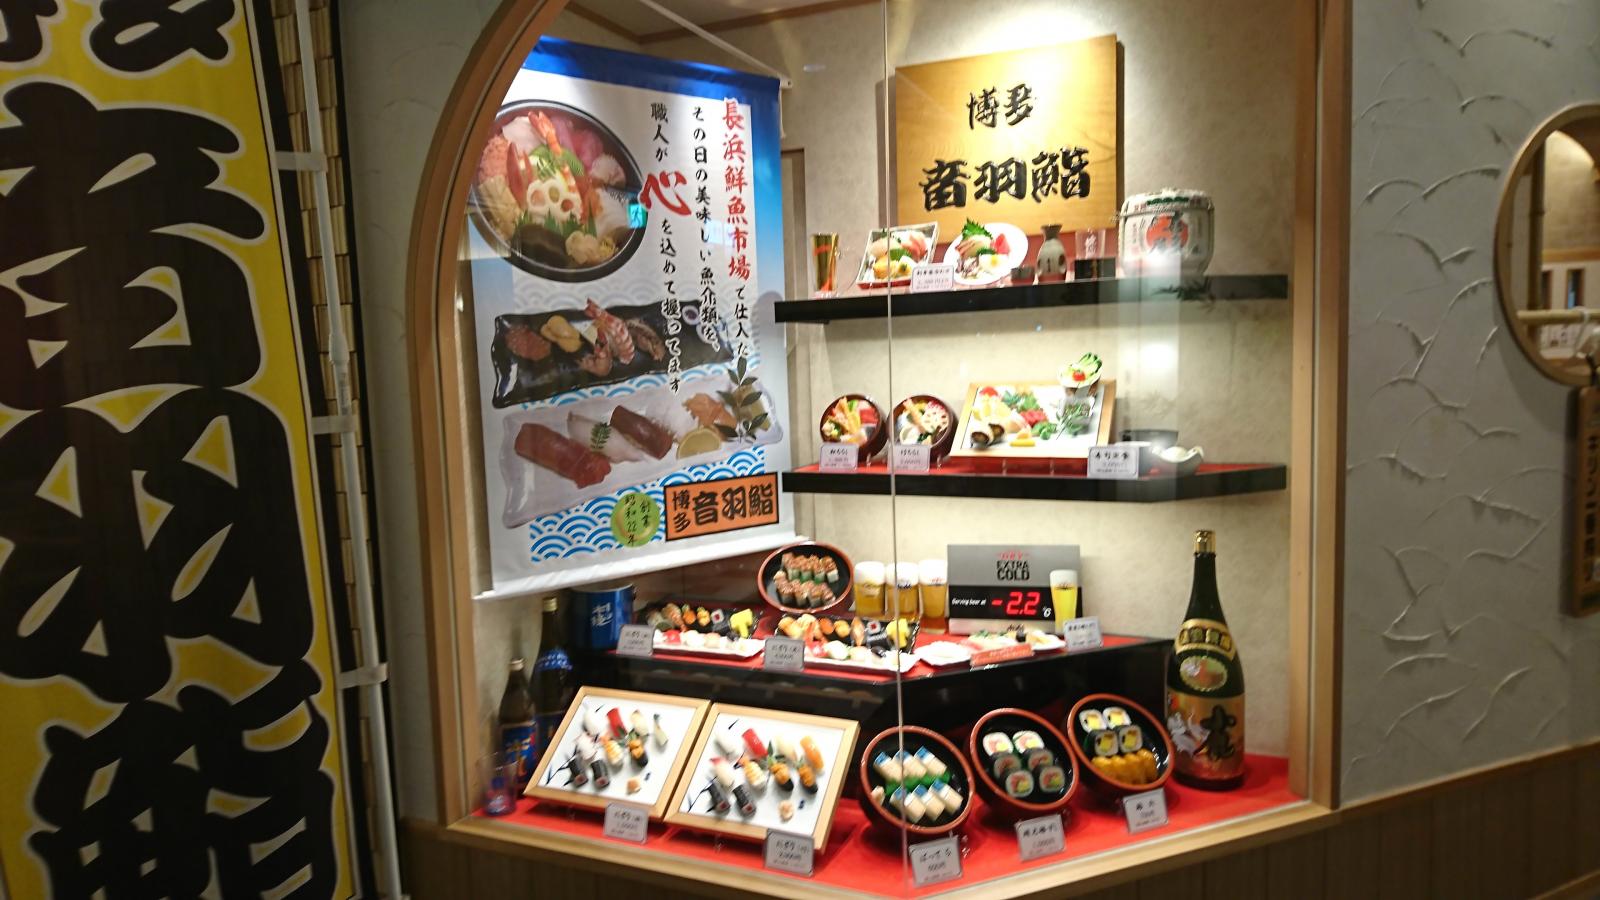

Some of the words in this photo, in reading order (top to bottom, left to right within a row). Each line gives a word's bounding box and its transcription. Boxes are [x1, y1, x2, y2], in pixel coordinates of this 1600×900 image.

[966, 82, 1035, 130] 博多
[918, 146, 1091, 212] 音羽鮨
[672, 489, 691, 533] 博多
[692, 483, 774, 526] 音羽鮨
[996, 560, 1030, 569] EXTRA
[996, 568, 1031, 581] COLD
